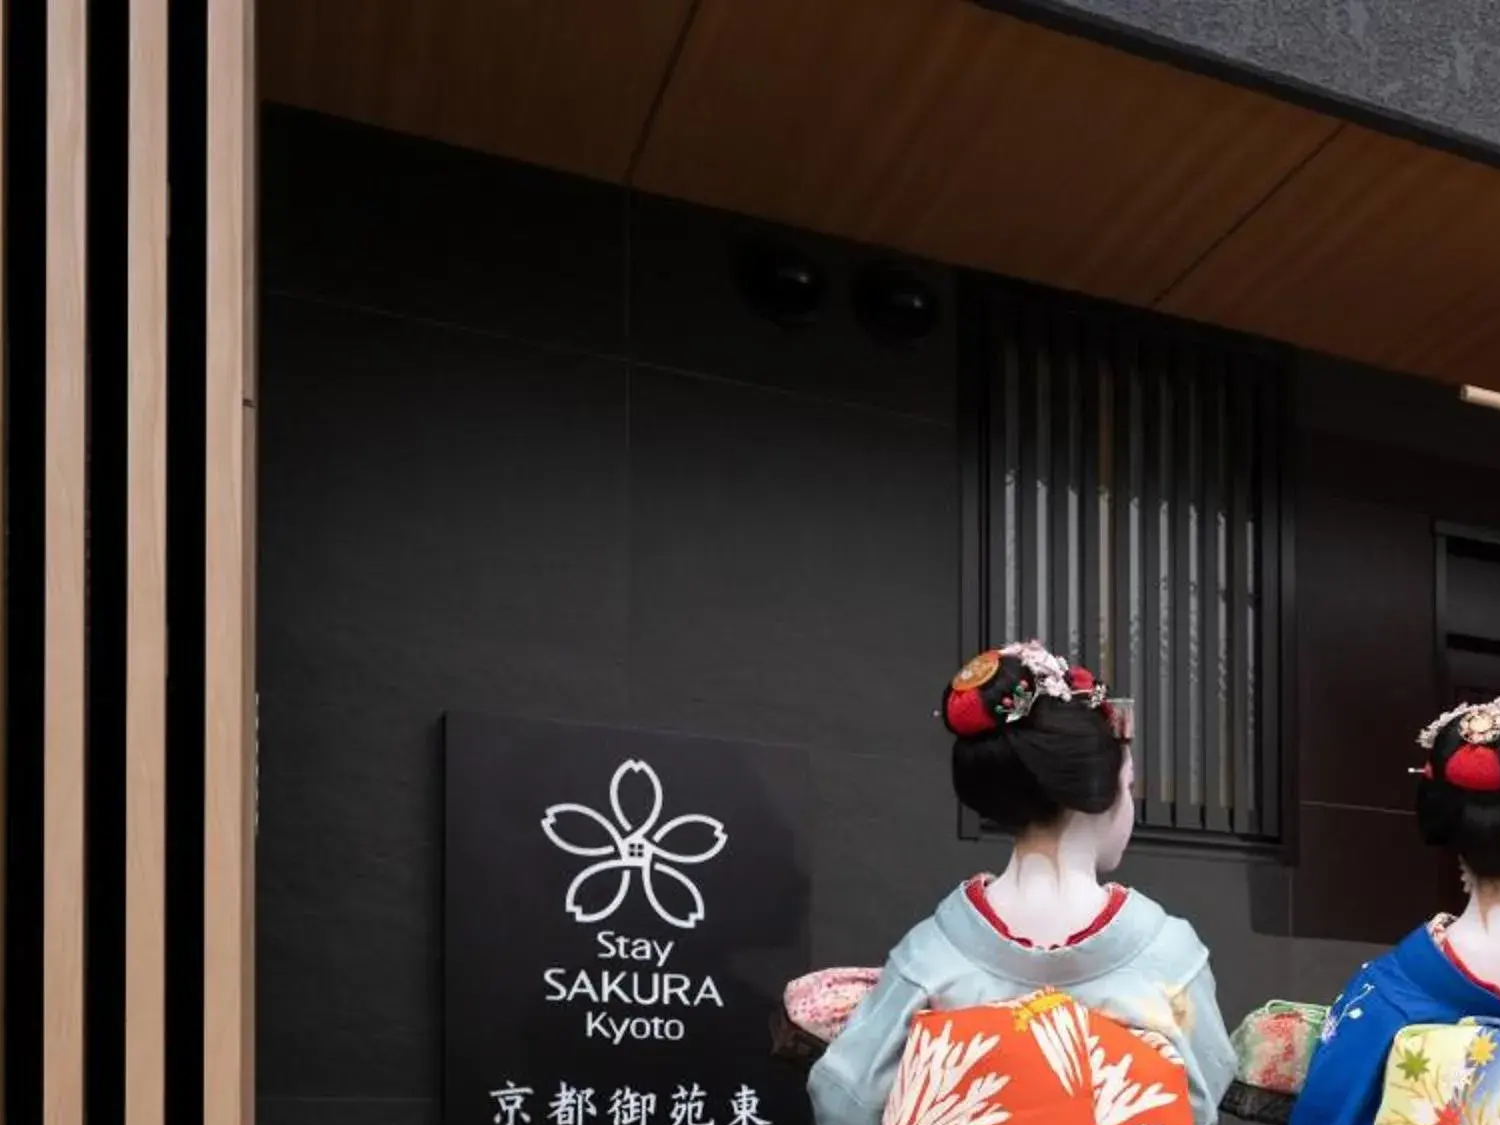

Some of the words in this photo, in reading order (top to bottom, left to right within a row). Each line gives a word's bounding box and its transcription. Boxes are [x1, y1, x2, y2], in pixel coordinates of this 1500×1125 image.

[596, 930, 674, 967] Stay
[543, 967, 724, 1007] SAKURA
[586, 1011, 686, 1045] Kyoto
